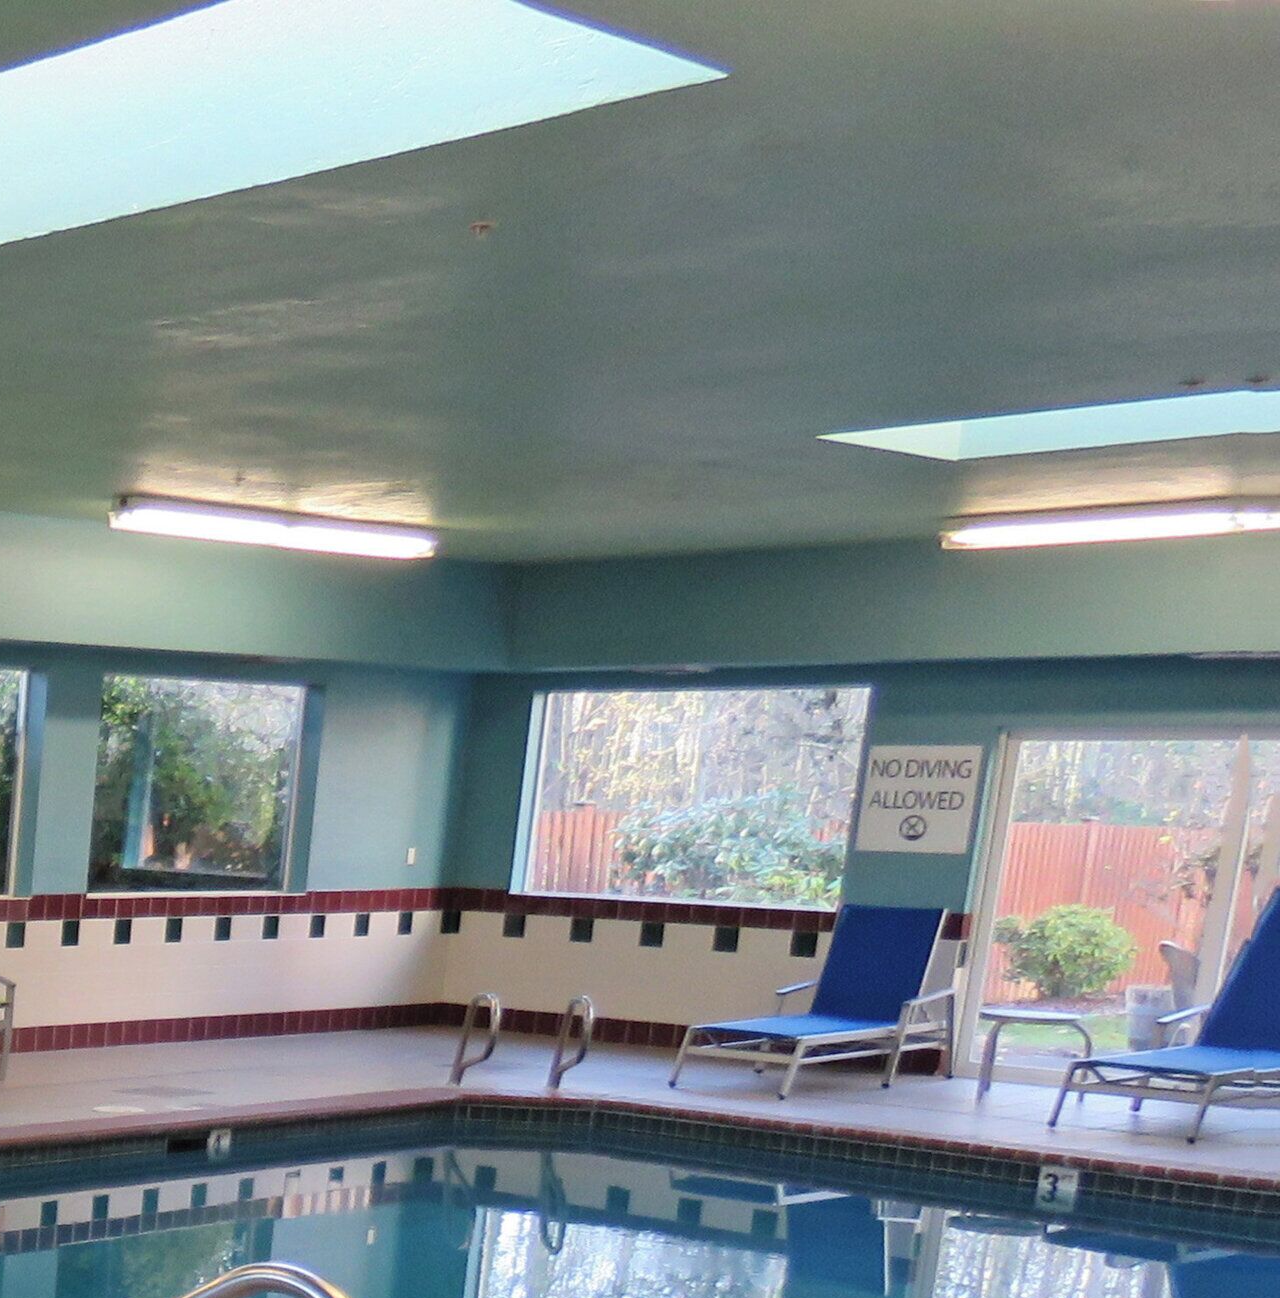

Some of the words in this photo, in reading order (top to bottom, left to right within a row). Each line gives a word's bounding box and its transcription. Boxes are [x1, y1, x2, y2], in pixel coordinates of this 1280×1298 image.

[871, 759, 901, 778] NO
[905, 759, 972, 779] DIVING
[870, 790, 964, 810] ALLOWED
[1042, 1172, 1059, 1203] 3
